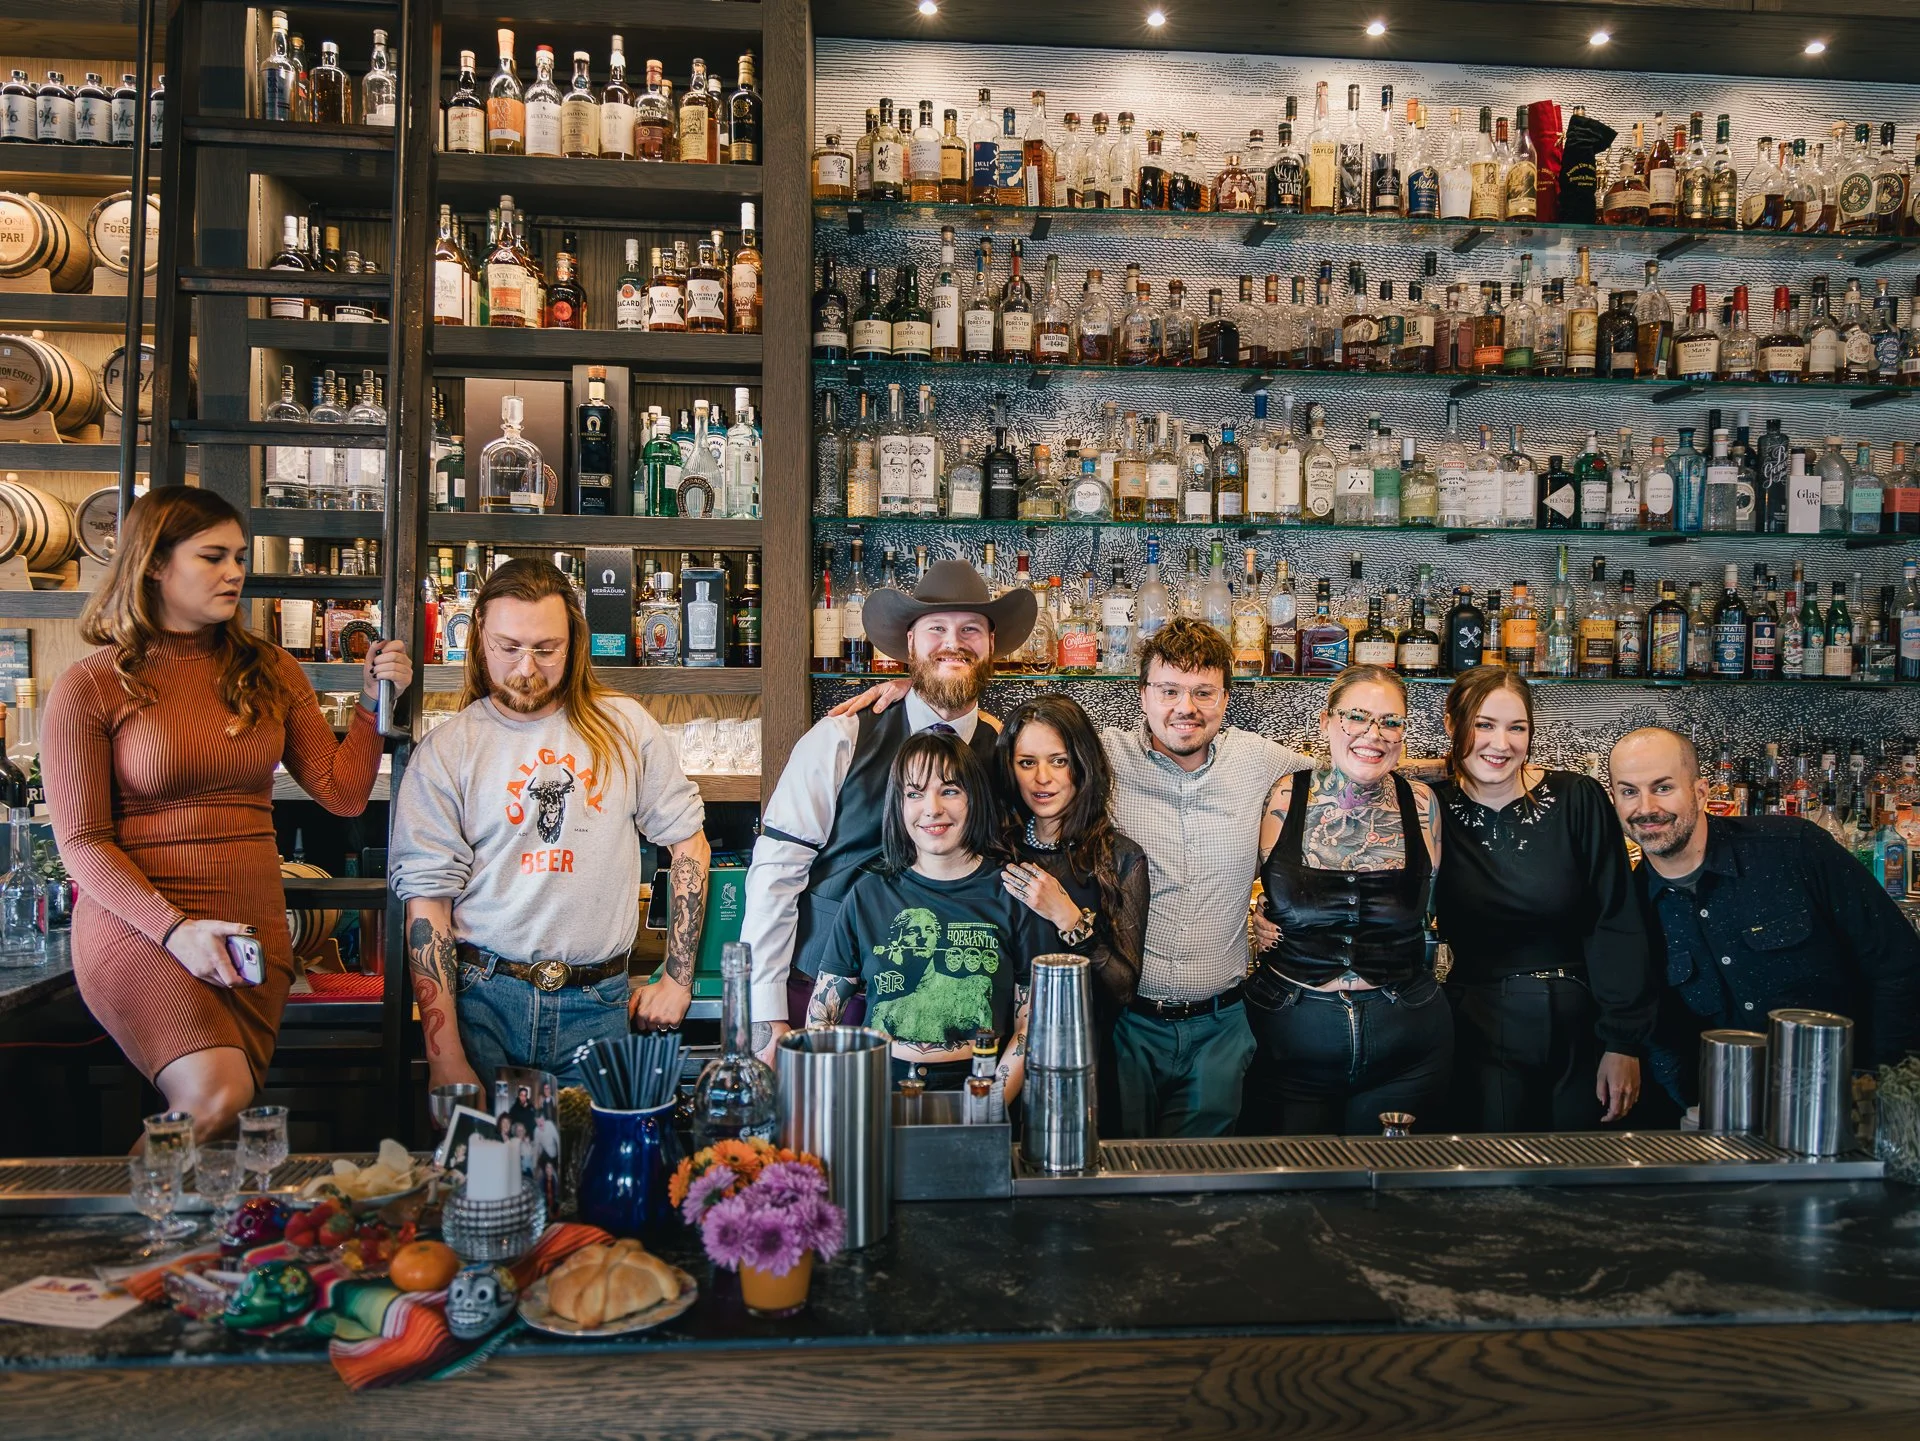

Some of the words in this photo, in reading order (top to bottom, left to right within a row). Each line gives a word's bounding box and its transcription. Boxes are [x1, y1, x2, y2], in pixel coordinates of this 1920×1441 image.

[820, 307, 844, 318] TEELING
[12, 368, 37, 385] ESTATE
[1797, 489, 1820, 499] Glas
[505, 748, 603, 825] CALGARY
[521, 849, 574, 874] BEER
[947, 930, 987, 942] HOPELESS
[953, 935, 999, 949] ROMANTIC
